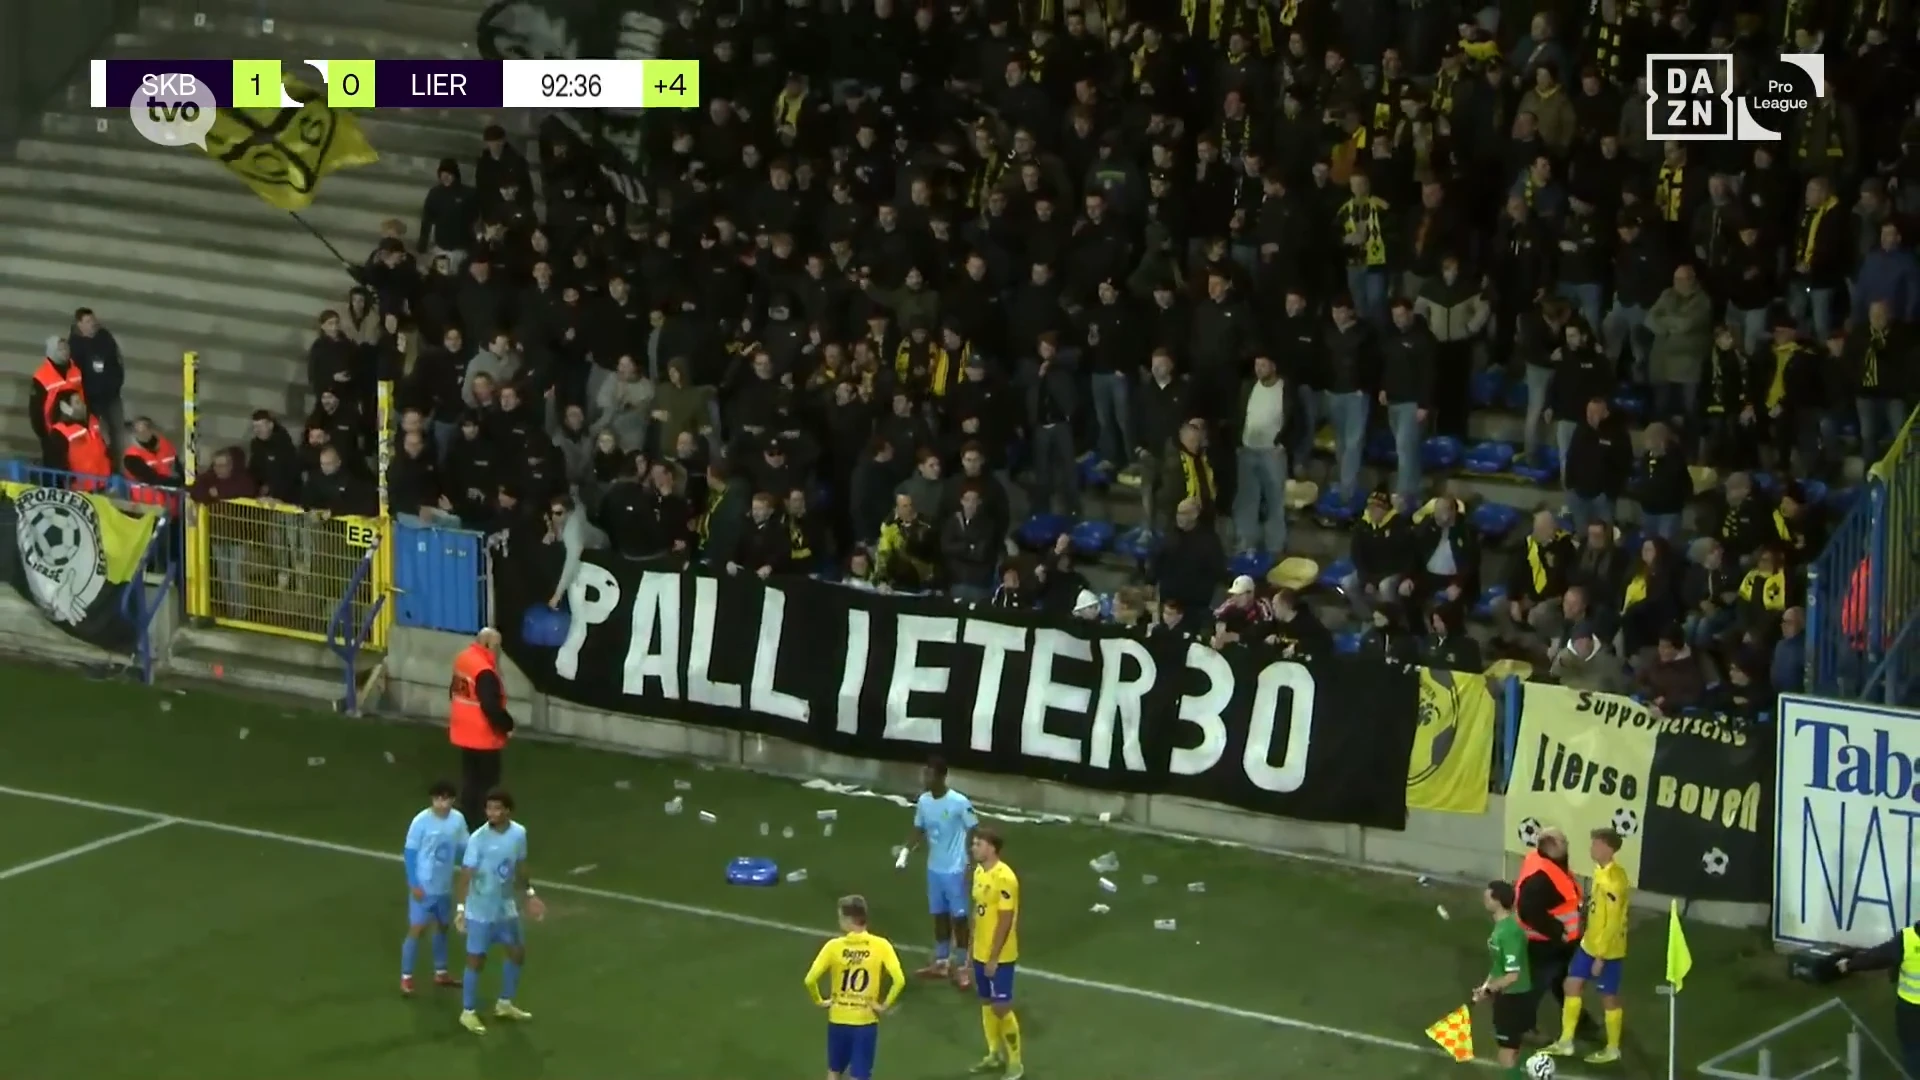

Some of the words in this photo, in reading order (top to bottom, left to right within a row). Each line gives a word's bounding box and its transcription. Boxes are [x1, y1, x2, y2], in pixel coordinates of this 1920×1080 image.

[348, 526, 374, 544] E2
[1169, 642, 1316, 793] 30
[1794, 717, 1920, 804] Tab
[841, 968, 870, 993] 10
